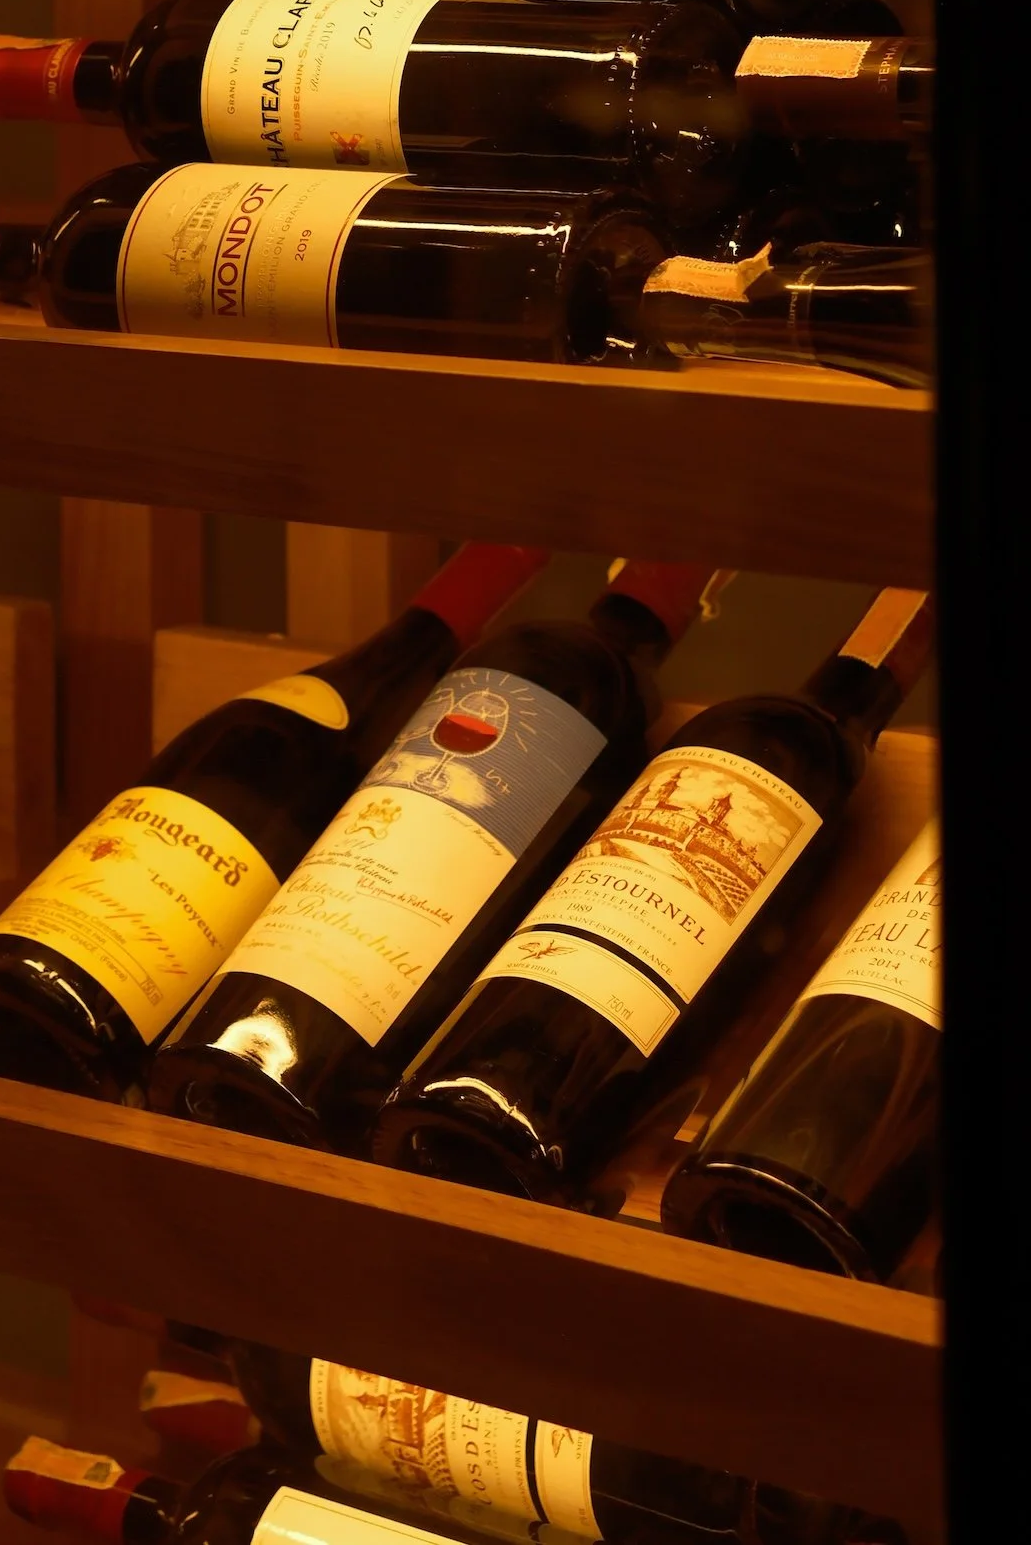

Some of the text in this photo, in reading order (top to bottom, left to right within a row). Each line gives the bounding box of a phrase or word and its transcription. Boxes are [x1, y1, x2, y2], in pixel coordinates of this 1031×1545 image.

[317, 21, 337, 51] 2019
[281, 194, 309, 233] GRAND
[217, 183, 275, 318] MONDOT
[293, 228, 313, 263] 2019
[719, 756, 738, 768] AU
[742, 764, 804, 811] CHATEAU
[566, 901, 594, 914] 1989
[905, 908, 931, 921] DE
[636, 944, 674, 977] FRANCE
[867, 956, 901, 971] 2014
[845, 968, 910, 987] PAUILLAC
